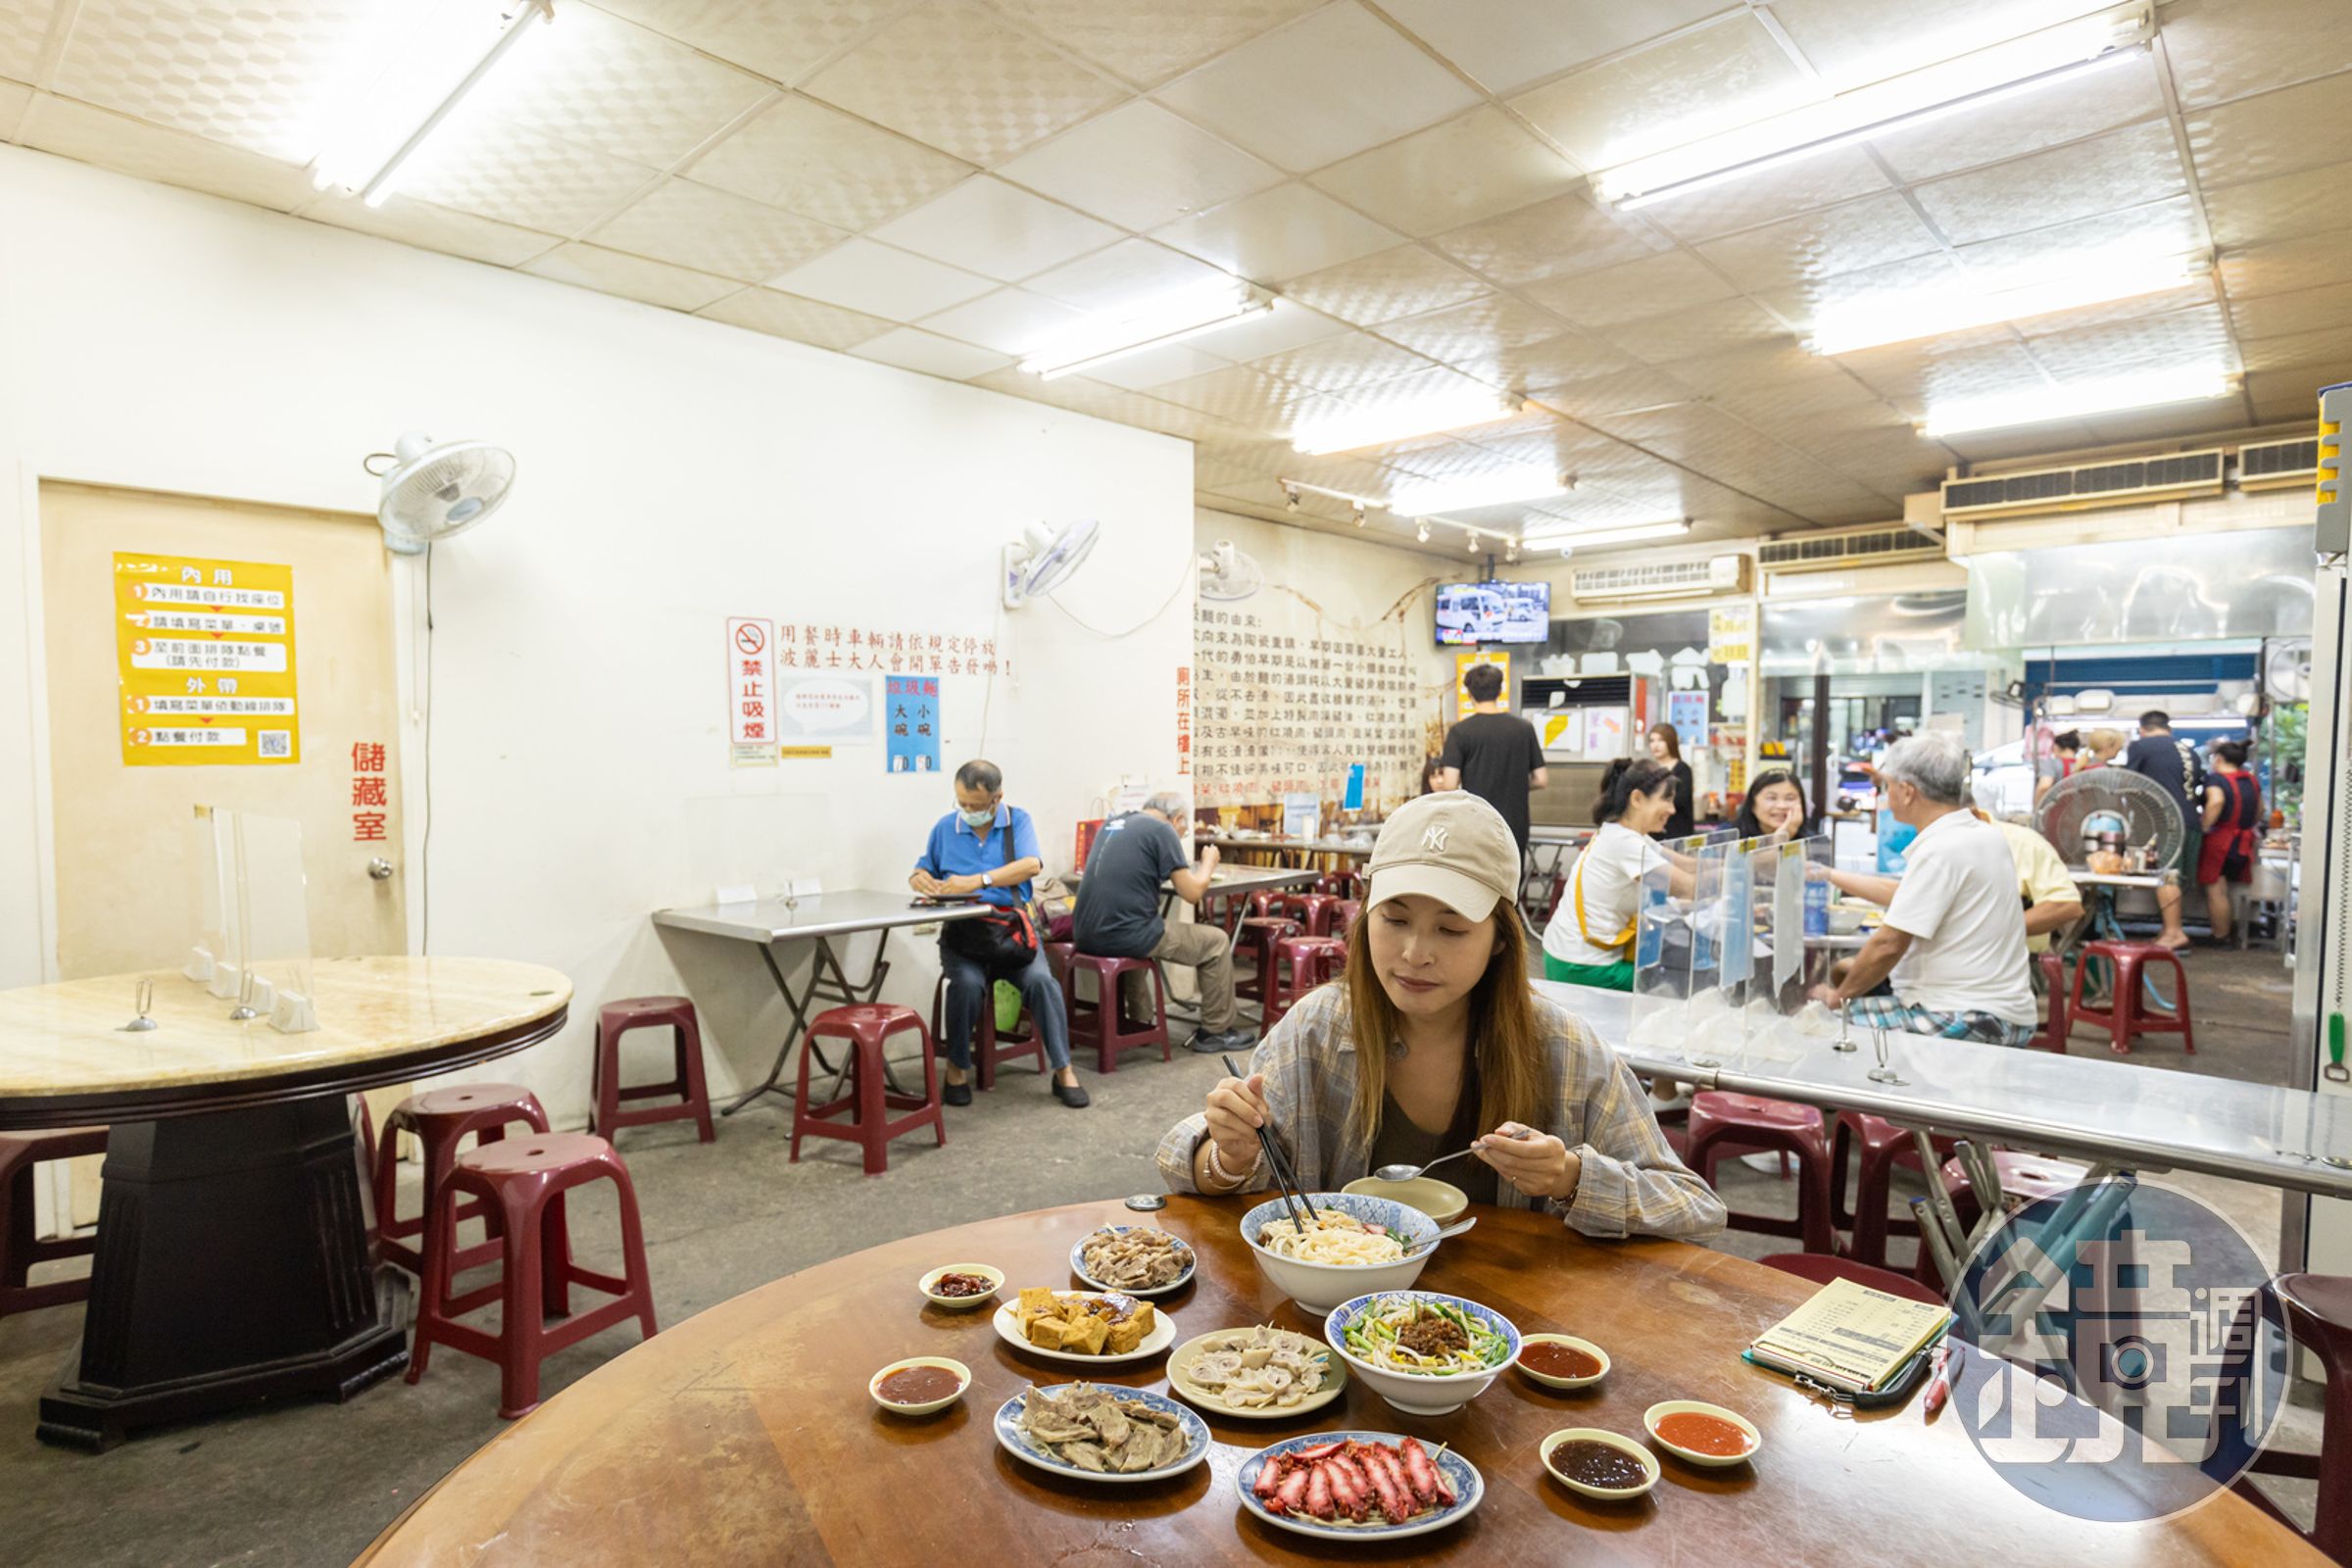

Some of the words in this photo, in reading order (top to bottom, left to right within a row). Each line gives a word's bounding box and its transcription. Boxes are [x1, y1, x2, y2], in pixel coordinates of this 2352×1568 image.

[181, 565, 234, 586] 內用
[780, 625, 996, 656] 用餐時車輛請依規定停放
[186, 677, 237, 694] 外帶
[742, 659, 765, 739] 禁止吸煙
[887, 680, 938, 697] 垃圾麵
[351, 742, 387, 842] 儲藏室
[1421, 825, 1448, 853] NY
